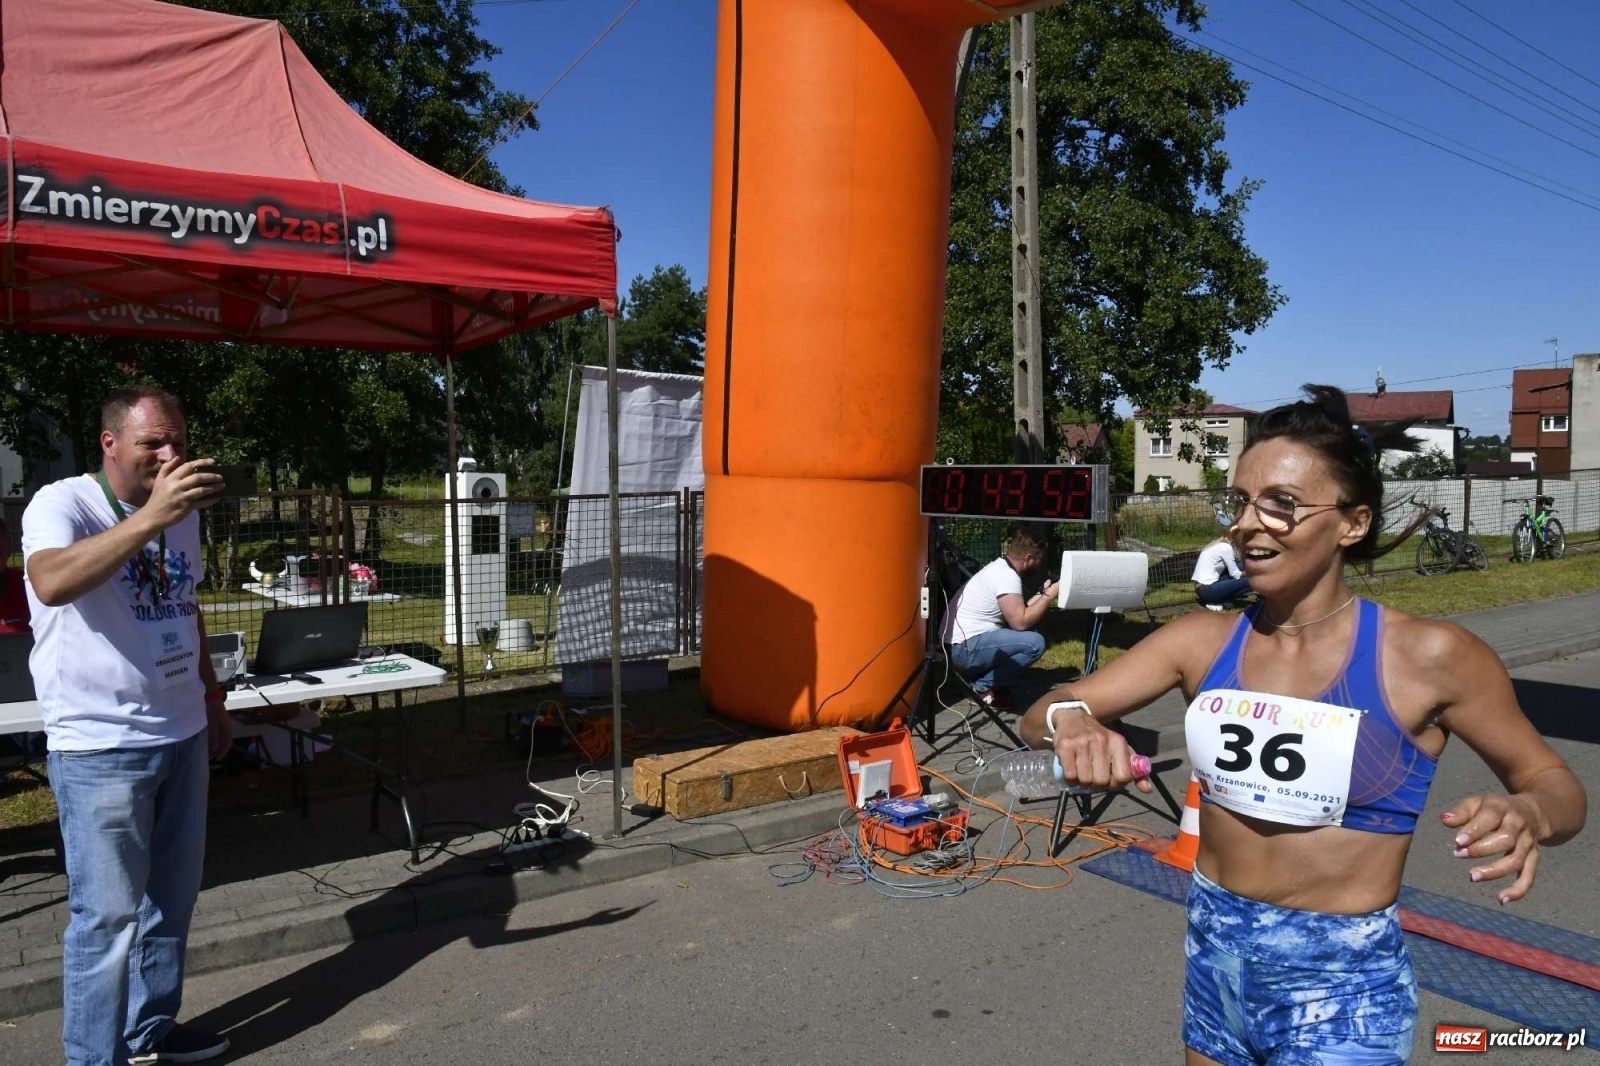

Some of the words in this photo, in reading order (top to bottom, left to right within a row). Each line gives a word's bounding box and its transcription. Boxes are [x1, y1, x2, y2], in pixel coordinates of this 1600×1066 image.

[983, 470, 1028, 515] 43
[1042, 470, 1092, 517] 52
[155, 651, 194, 667] ORGANIZATOR
[1199, 696, 1282, 725] COLOUR
[1214, 723, 1306, 782] 36
[1216, 774, 1271, 793] Krzanowice,
[1277, 787, 1341, 804] 05.09.2021
